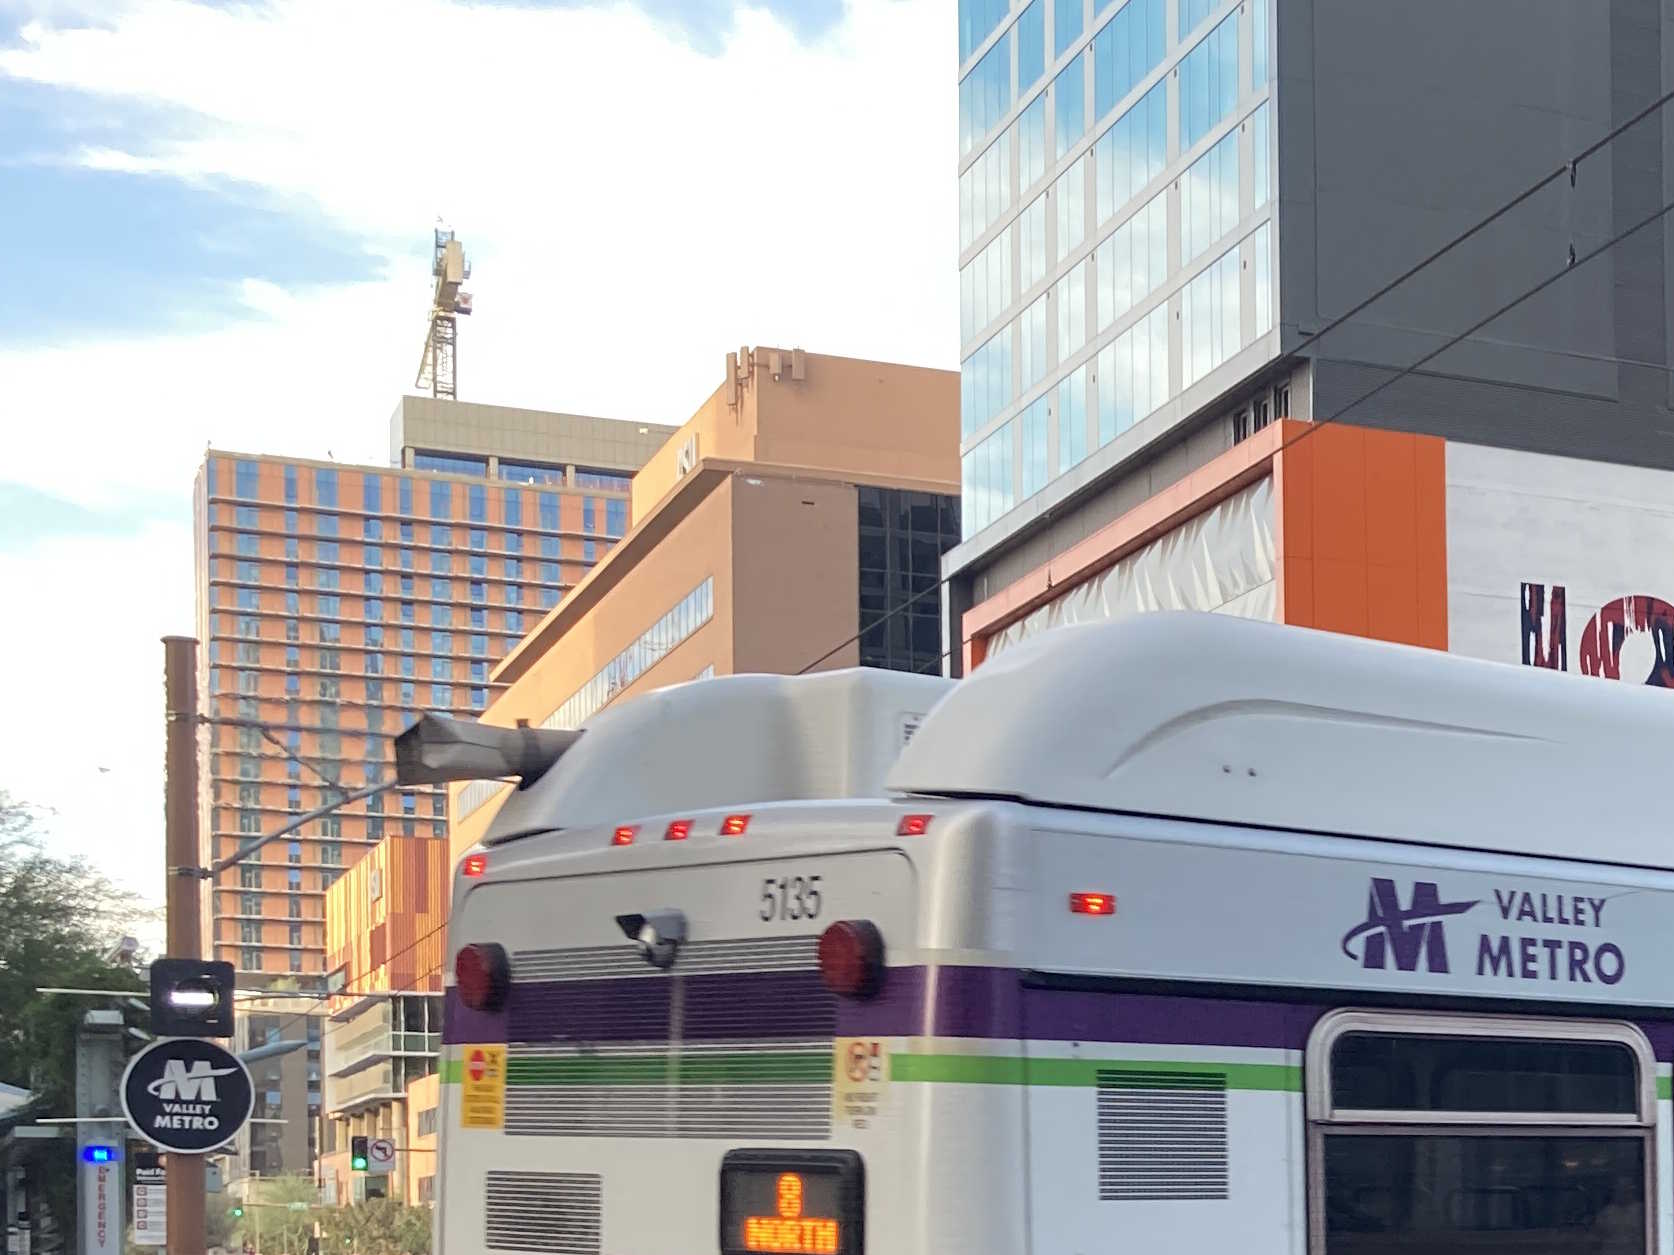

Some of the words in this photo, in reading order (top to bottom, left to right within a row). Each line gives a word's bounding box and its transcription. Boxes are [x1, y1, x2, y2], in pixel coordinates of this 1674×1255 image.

[760, 876, 823, 922] 5135
[1493, 888, 1606, 929] VALLEY
[1476, 934, 1625, 986] METRO
[153, 1115, 220, 1131] METRO
[162, 1103, 213, 1114] VALLEY
[97, 1165, 107, 1248] EMERGENCY
[777, 1172, 803, 1218] 8
[745, 1216, 839, 1255] NORTH
